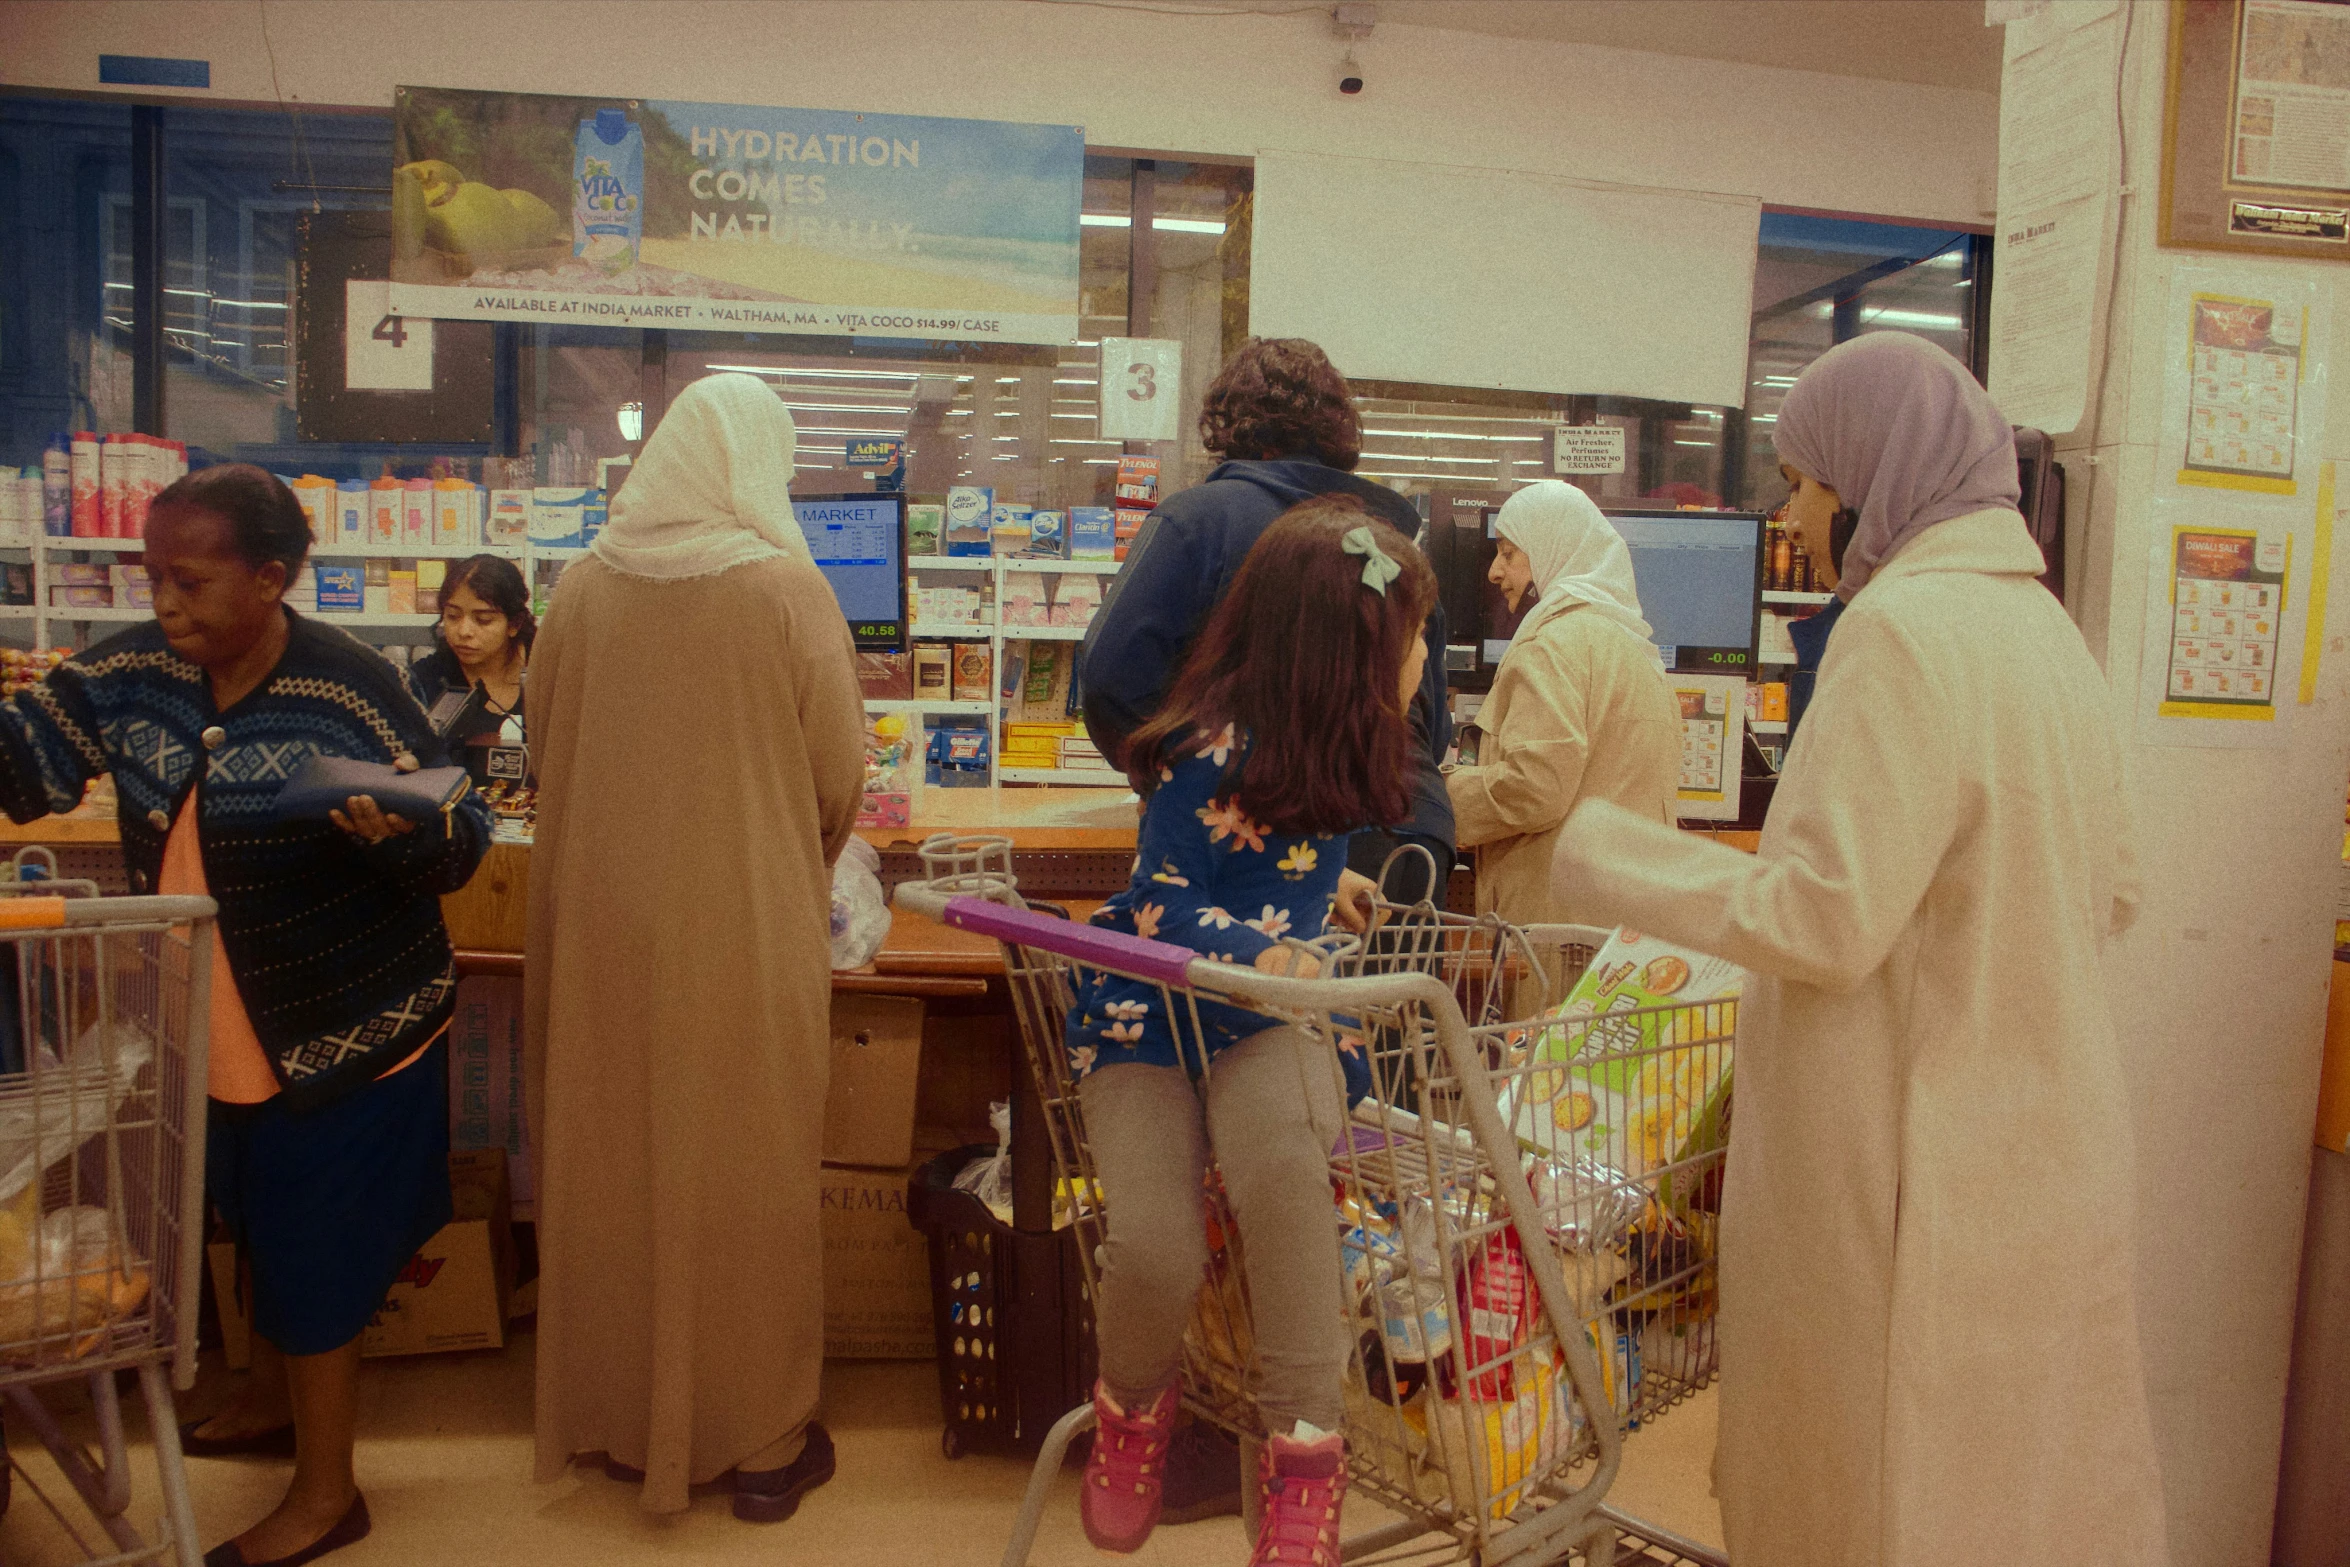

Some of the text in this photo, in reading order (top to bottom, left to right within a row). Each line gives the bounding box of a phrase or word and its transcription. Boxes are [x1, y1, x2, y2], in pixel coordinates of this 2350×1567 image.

[690, 126, 920, 168] HYDRATION
[580, 175, 624, 197] VITA
[688, 169, 827, 204] COMES
[587, 194, 637, 211] COCO
[689, 211, 920, 252] NATURALLY.
[474, 297, 557, 313] AVAILABLE
[560, 301, 578, 313] AT
[583, 302, 627, 315] INDIA
[630, 304, 692, 319] MARKET
[711, 307, 791, 325] WALTHAM,
[794, 313, 818, 325] MA
[836, 313, 867, 327] VITA
[871, 315, 914, 328] COCO
[963, 318, 1000, 332] CASE
[371, 314, 408, 348] 4
[1126, 362, 1157, 402] 3
[854, 442, 889, 455] Advil
[1120, 457, 1158, 469] TYLENOL
[1452, 497, 1489, 507] Lenovo
[802, 508, 878, 522] MARKET
[1074, 523, 1100, 531] Claritin
[2186, 540, 2240, 554] DIWALI SALE
[859, 625, 897, 636] 40.58
[1707, 652, 1746, 664] -0.00
[950, 737, 983, 746] Gillette
[820, 1187, 907, 1212] KEMA
